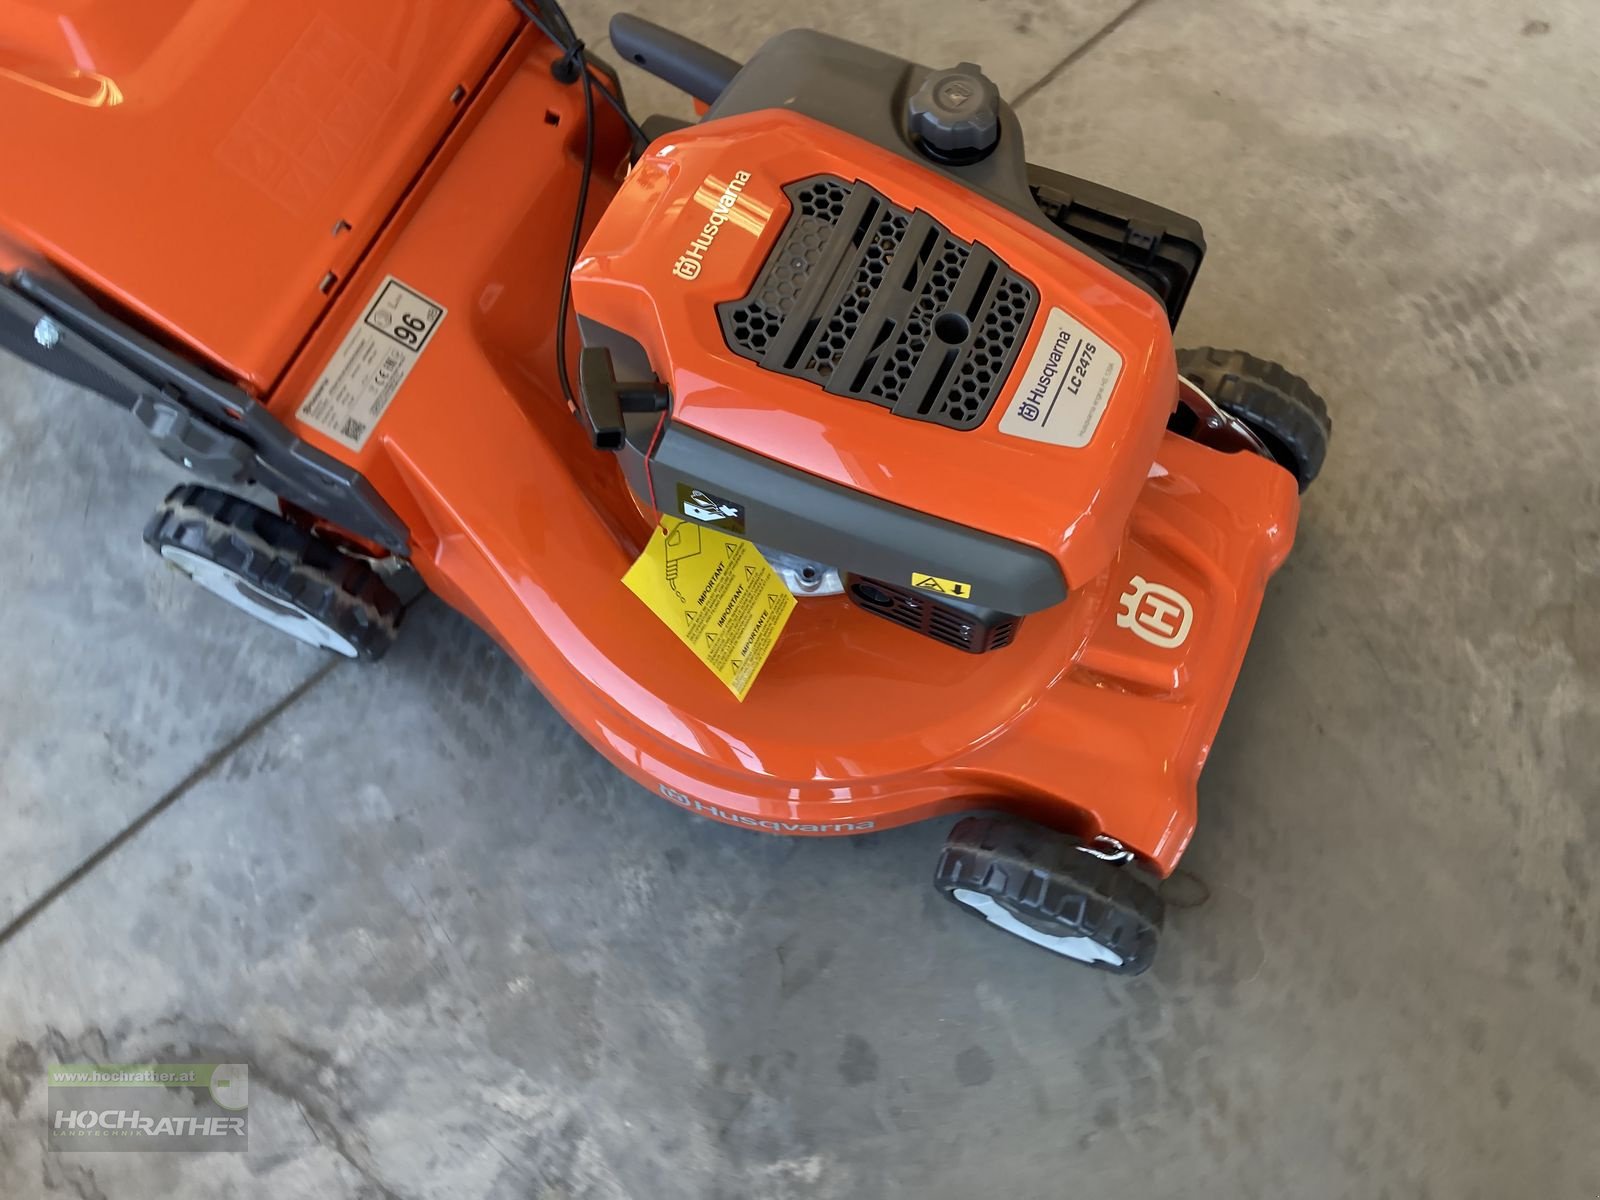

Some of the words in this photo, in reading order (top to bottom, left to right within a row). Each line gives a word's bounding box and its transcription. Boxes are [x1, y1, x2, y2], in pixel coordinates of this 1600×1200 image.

[685, 170, 751, 260] Husqvarna
[393, 313, 425, 344] 96
[1027, 330, 1071, 405] Husqvarna
[1067, 375, 1082, 395] LC
[1075, 342, 1097, 378] 247S
[697, 560, 726, 606] IMPORTANT
[718, 584, 745, 628] IMPORTANT
[742, 611, 769, 657] IMPORTANTE
[695, 800, 876, 832] Husqvarna
